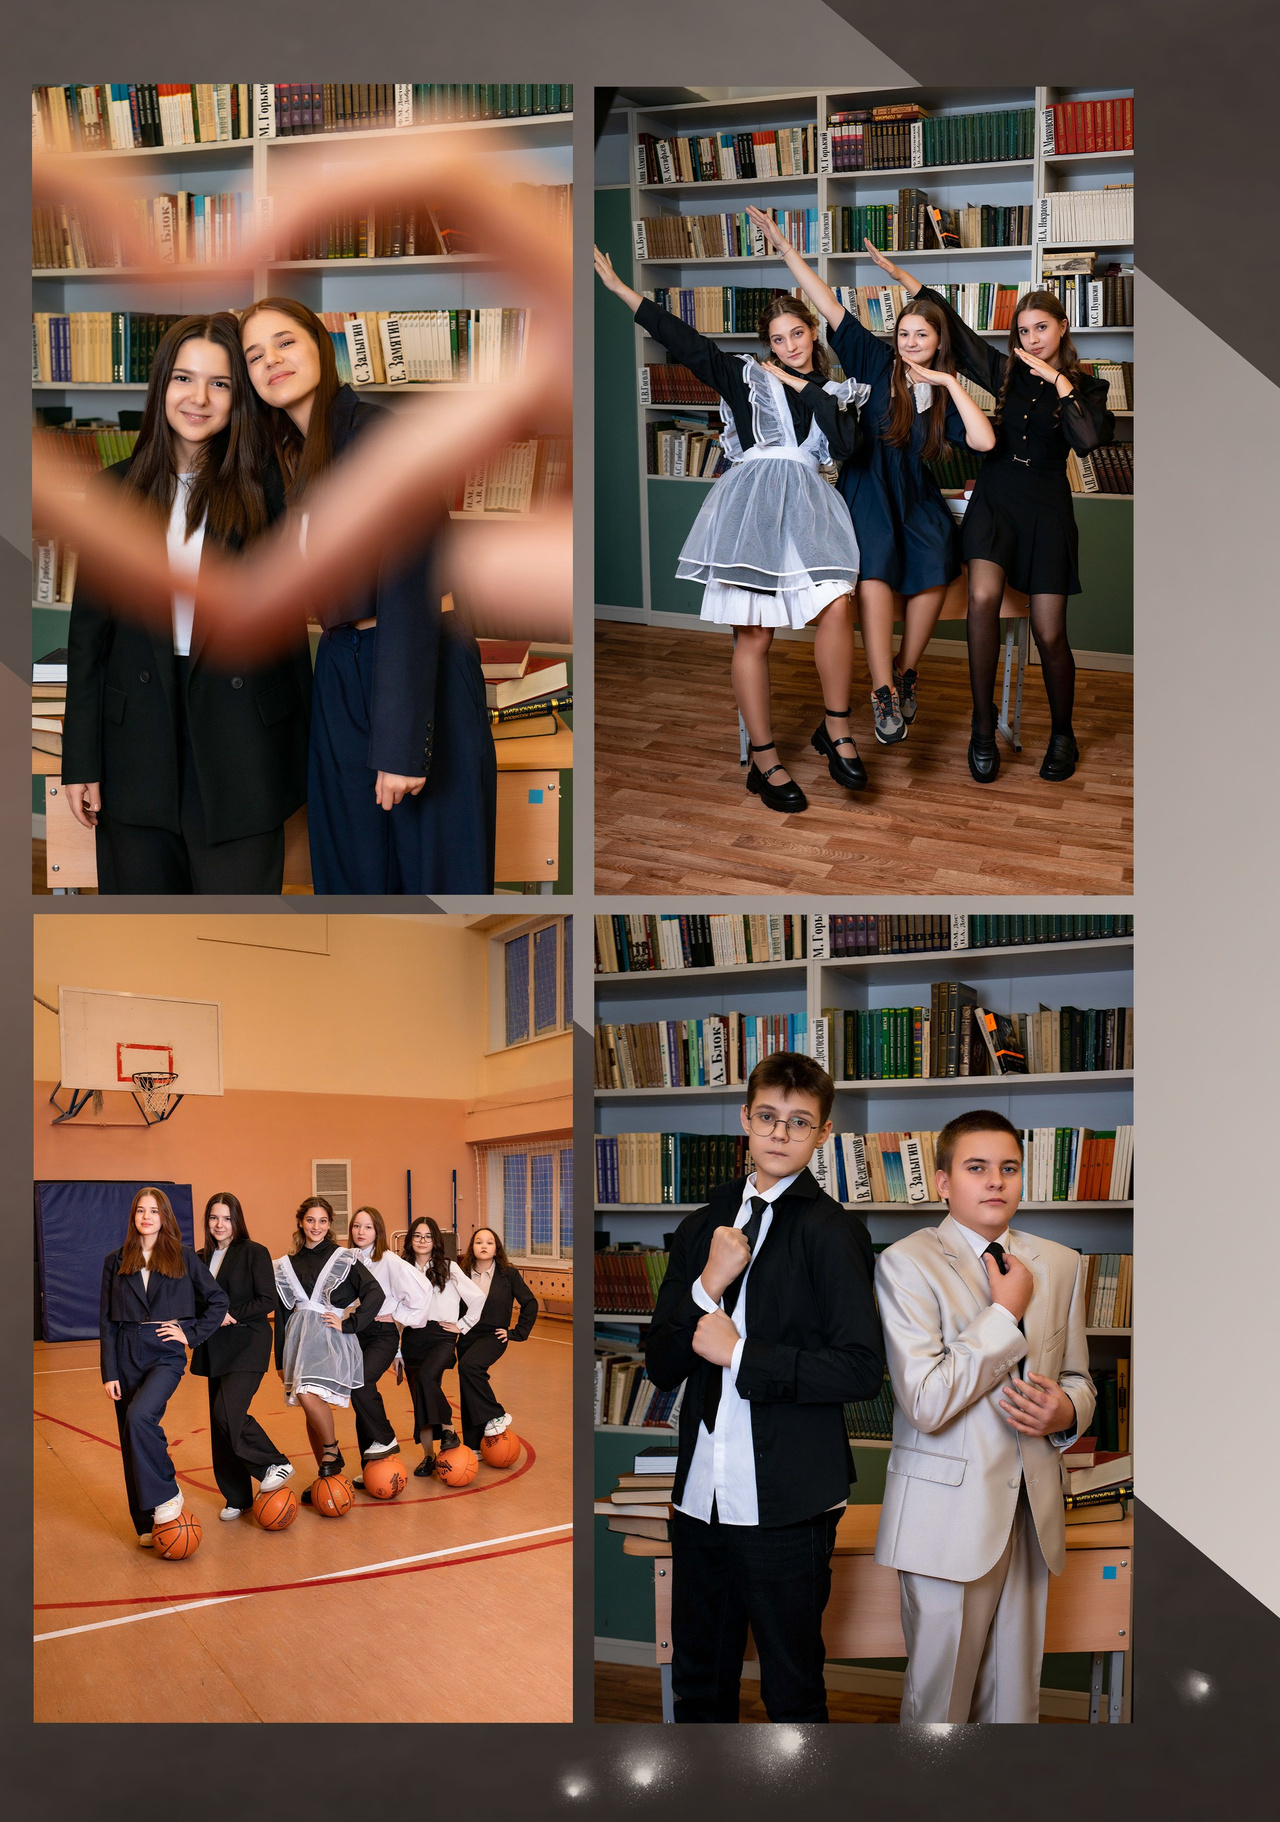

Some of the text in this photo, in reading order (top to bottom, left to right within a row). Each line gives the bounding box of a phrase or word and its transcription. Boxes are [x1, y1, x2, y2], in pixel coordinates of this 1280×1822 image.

[260, 123, 270, 137] М.
[1042, 109, 1054, 147] Маяковский
[637, 146, 646, 171] Ахматова
[660, 143, 671, 174] Астафьев
[820, 132, 830, 173] М. Горький
[160, 206, 171, 243] Блок
[821, 212, 831, 240] Достоевский
[1037, 199, 1050, 242] Н.А. Некрасов
[756, 244, 765, 254] А.
[882, 292, 893, 322] Залыгин
[1090, 285, 1101, 326] А.С. Пушкин
[351, 323, 370, 383] С. Залыгин
[386, 320, 406, 383] Е. Замятин
[674, 440, 683, 465] Грибоедов
[40, 547, 52, 585] Грибоедов
[813, 944, 823, 958] М.
[710, 1026, 723, 1083] А. Блок
[813, 1019, 826, 1062] Достоевский
[852, 1138, 870, 1199] В. Железников
[907, 1142, 925, 1201] С. Залыгин
